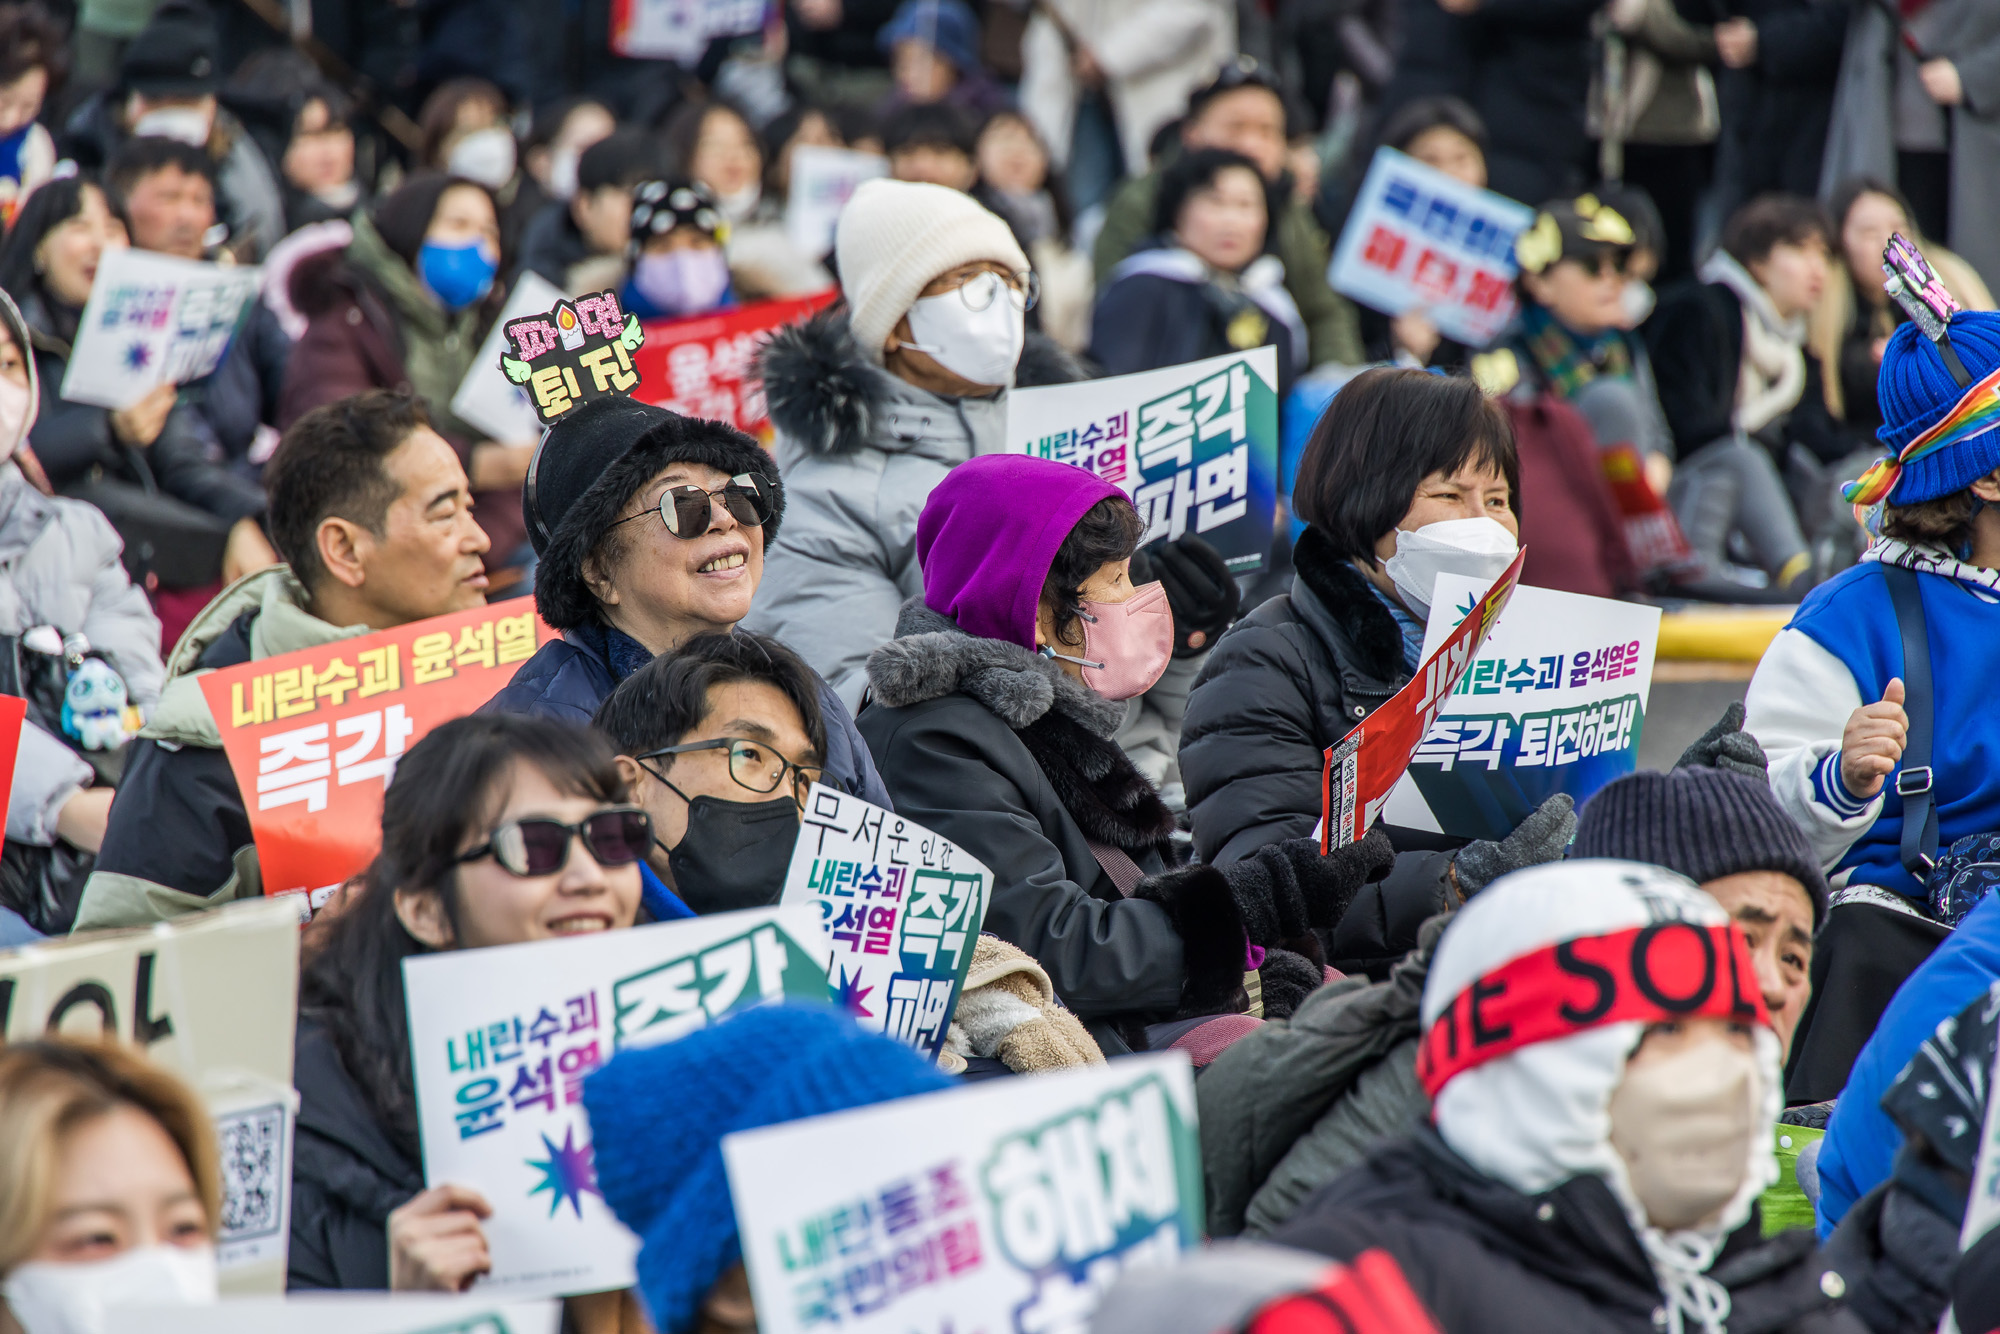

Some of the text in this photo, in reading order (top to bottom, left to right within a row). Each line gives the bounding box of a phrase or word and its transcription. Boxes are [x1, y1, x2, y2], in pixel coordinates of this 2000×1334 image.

[508, 292, 625, 362] 파면
[531, 339, 638, 418] 퇴진
[1136, 363, 1251, 472] 즉각
[1134, 443, 1249, 549] 파면
[231, 612, 538, 728] 내란수괴 윤석열
[1569, 639, 1641, 689] 윤석열은
[256, 703, 414, 814] 즉각
[1410, 698, 1638, 772] 즉각 퇴진하라!
[804, 791, 954, 871] 무서운 인간
[807, 858, 907, 903] 내란수괴
[902, 875, 981, 971] 즉각
[446, 988, 599, 1074] 내란수괴
[455, 1038, 601, 1141] 윤석열
